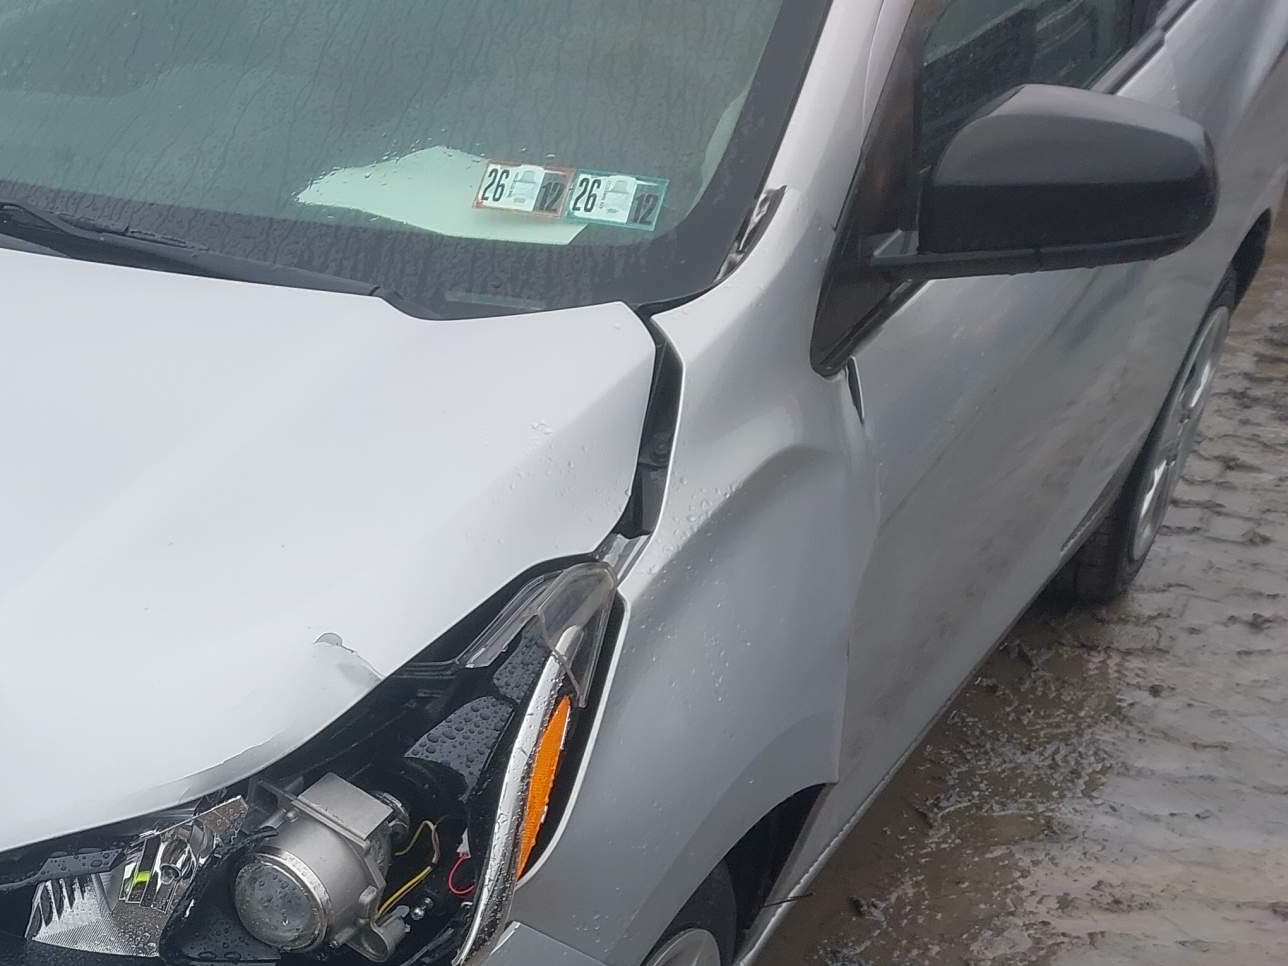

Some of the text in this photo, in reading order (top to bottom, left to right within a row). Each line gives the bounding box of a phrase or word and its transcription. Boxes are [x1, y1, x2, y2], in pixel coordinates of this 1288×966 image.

[481, 167, 510, 202] 26
[538, 182, 565, 212] 12
[572, 177, 601, 213] 26
[632, 194, 658, 224] 12
